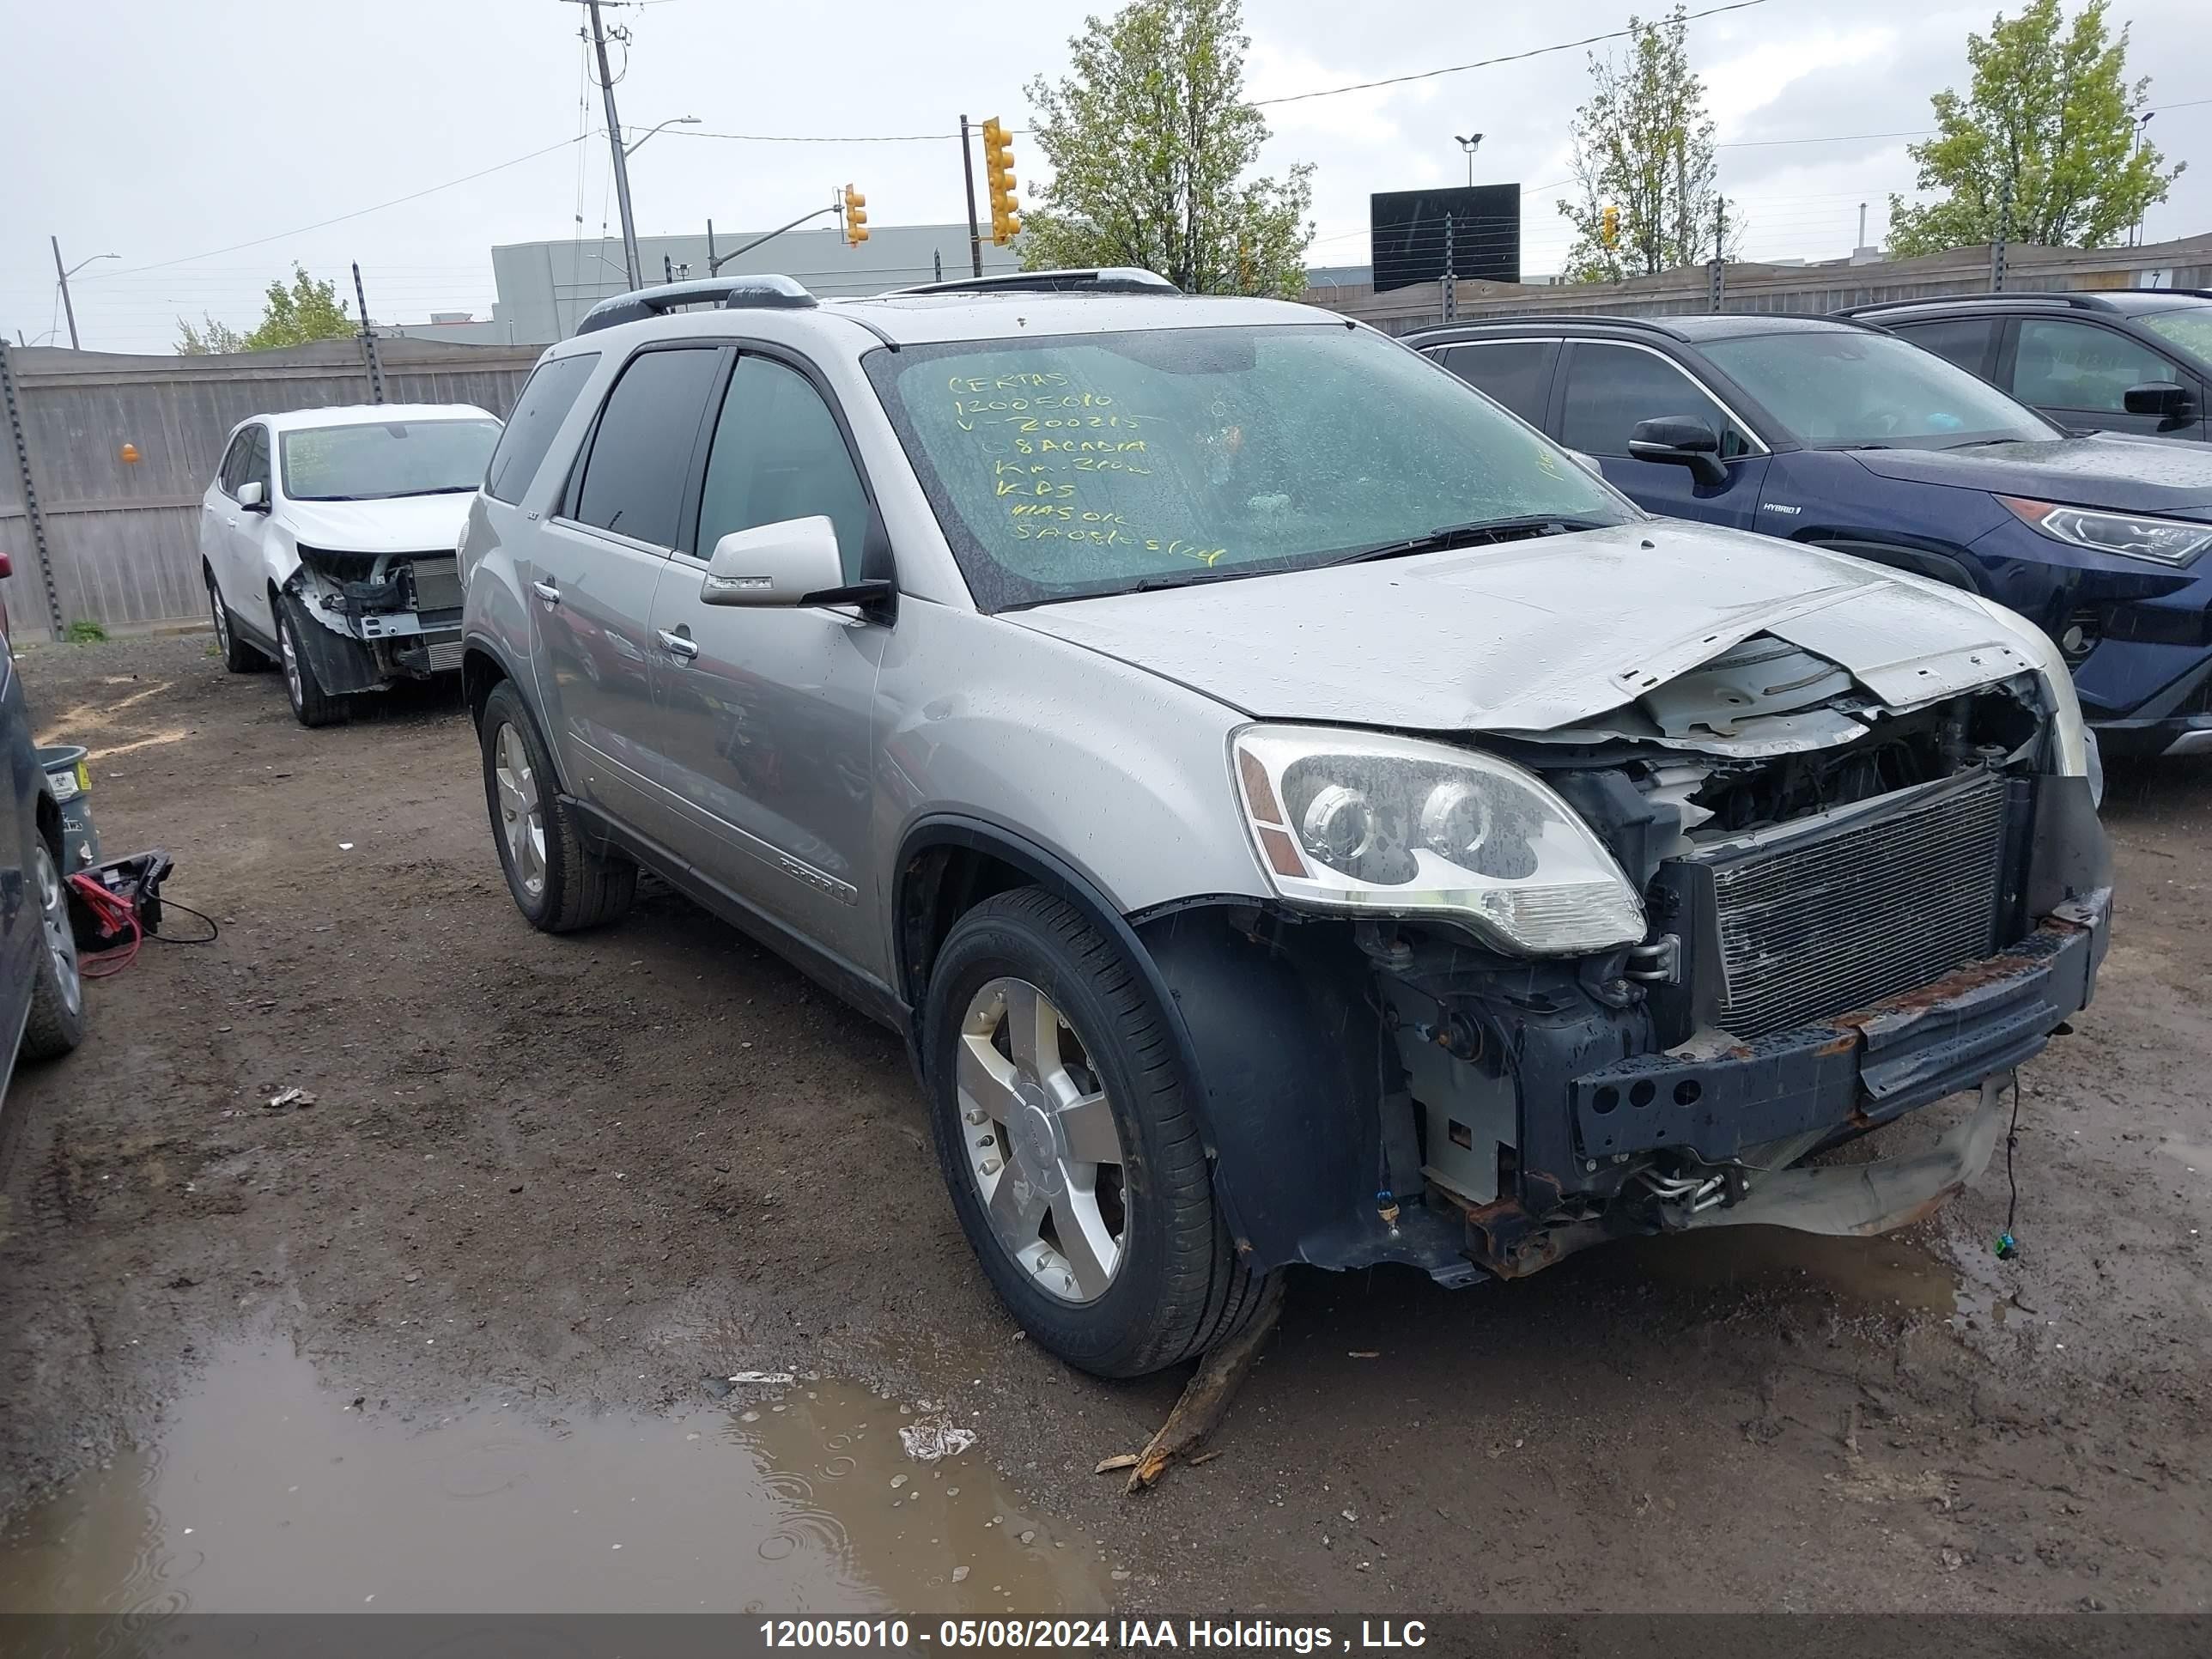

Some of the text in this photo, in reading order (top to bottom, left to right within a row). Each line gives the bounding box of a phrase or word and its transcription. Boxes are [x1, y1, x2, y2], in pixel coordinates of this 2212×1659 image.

[949, 373, 1068, 394] CERTAS
[955, 392, 1113, 416] 12005010
[1763, 502, 1795, 514] HYBRID
